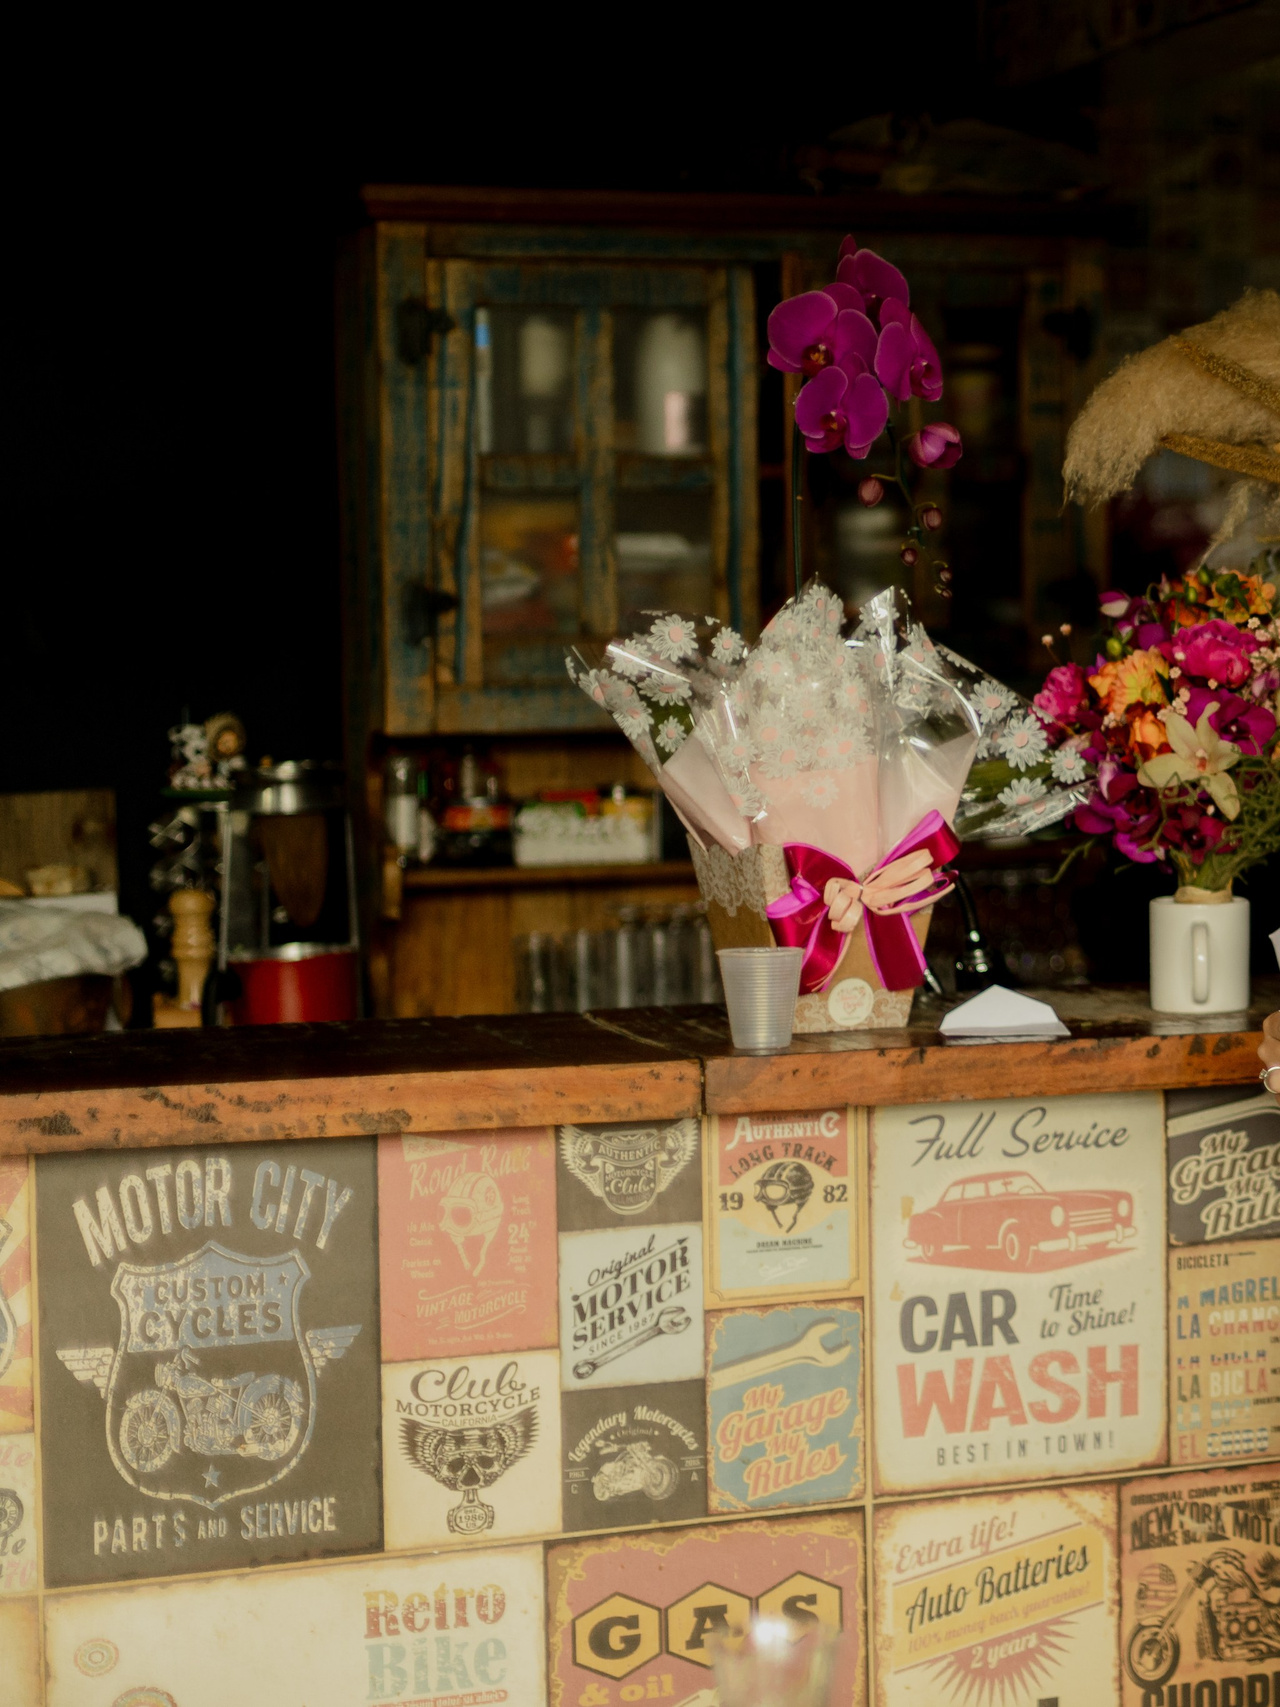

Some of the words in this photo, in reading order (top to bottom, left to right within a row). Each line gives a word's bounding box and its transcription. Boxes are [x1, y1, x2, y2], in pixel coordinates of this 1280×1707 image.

[598, 1140, 661, 1160] AUTHENTIC
[908, 1110, 995, 1167] Full
[1001, 1106, 1131, 1159] Service
[1201, 1131, 1247, 1154] My
[408, 1152, 468, 1201] Road
[604, 1168, 655, 1182] MOTORCYCLE
[728, 1144, 775, 1180] LONG
[782, 1142, 838, 1171] TRACK
[610, 1176, 650, 1196] Club
[718, 1192, 744, 1211] 19
[823, 1184, 848, 1203] 82
[72, 1157, 233, 1267] MOTOR
[250, 1160, 354, 1250] CITY
[588, 1234, 655, 1287] Original
[1176, 1252, 1230, 1270] BICICLETA
[153, 1273, 266, 1305] CUSTOM
[416, 1292, 474, 1318] VINTAGE
[573, 1246, 690, 1328] MOTOR
[1049, 1282, 1104, 1313] Time
[139, 1302, 282, 1345] CYCLES
[454, 1290, 527, 1324] MOTORCYCLE
[573, 1269, 691, 1351] SERVICE
[900, 1289, 1020, 1354] CAR
[1040, 1316, 1061, 1340] to
[1068, 1303, 1137, 1337] Shine!
[1176, 1312, 1202, 1340] LA
[588, 1330, 624, 1355] SINCE
[628, 1313, 655, 1334] 1987
[410, 1361, 526, 1403] Club
[745, 1384, 783, 1409] My
[896, 1343, 1140, 1440] WASH
[1177, 1374, 1202, 1403] LA
[1209, 1367, 1269, 1399] BICLA
[395, 1386, 541, 1418] MOTORCYCLE
[441, 1414, 498, 1428] CALIFORNIA
[568, 1411, 627, 1463] Legendary
[633, 1405, 699, 1451] Motorcycles
[718, 1388, 848, 1460] Garage
[937, 1442, 991, 1467] BEST
[1006, 1438, 1027, 1459] IN
[1043, 1429, 1115, 1457] TOWN!
[745, 1443, 841, 1499] Rules
[1188, 1483, 1246, 1499] COMPANY
[93, 1511, 186, 1556] PARTS
[197, 1517, 227, 1540] AND
[240, 1496, 337, 1540] SERVICE
[458, 1513, 485, 1524] 1986
[896, 1534, 963, 1575] Extra
[905, 1583, 972, 1634] Auto
[975, 1544, 1090, 1606] Batteries
[363, 1582, 507, 1639] Retro
[588, 1593, 820, 1660] GAS
[908, 1627, 943, 1653] 100%
[944, 1617, 987, 1642] money
[989, 1605, 1020, 1627] back
[364, 1636, 508, 1701] Bike
[970, 1645, 985, 1670] 2
[987, 1631, 1040, 1670] years
[620, 1673, 676, 1702] oil
